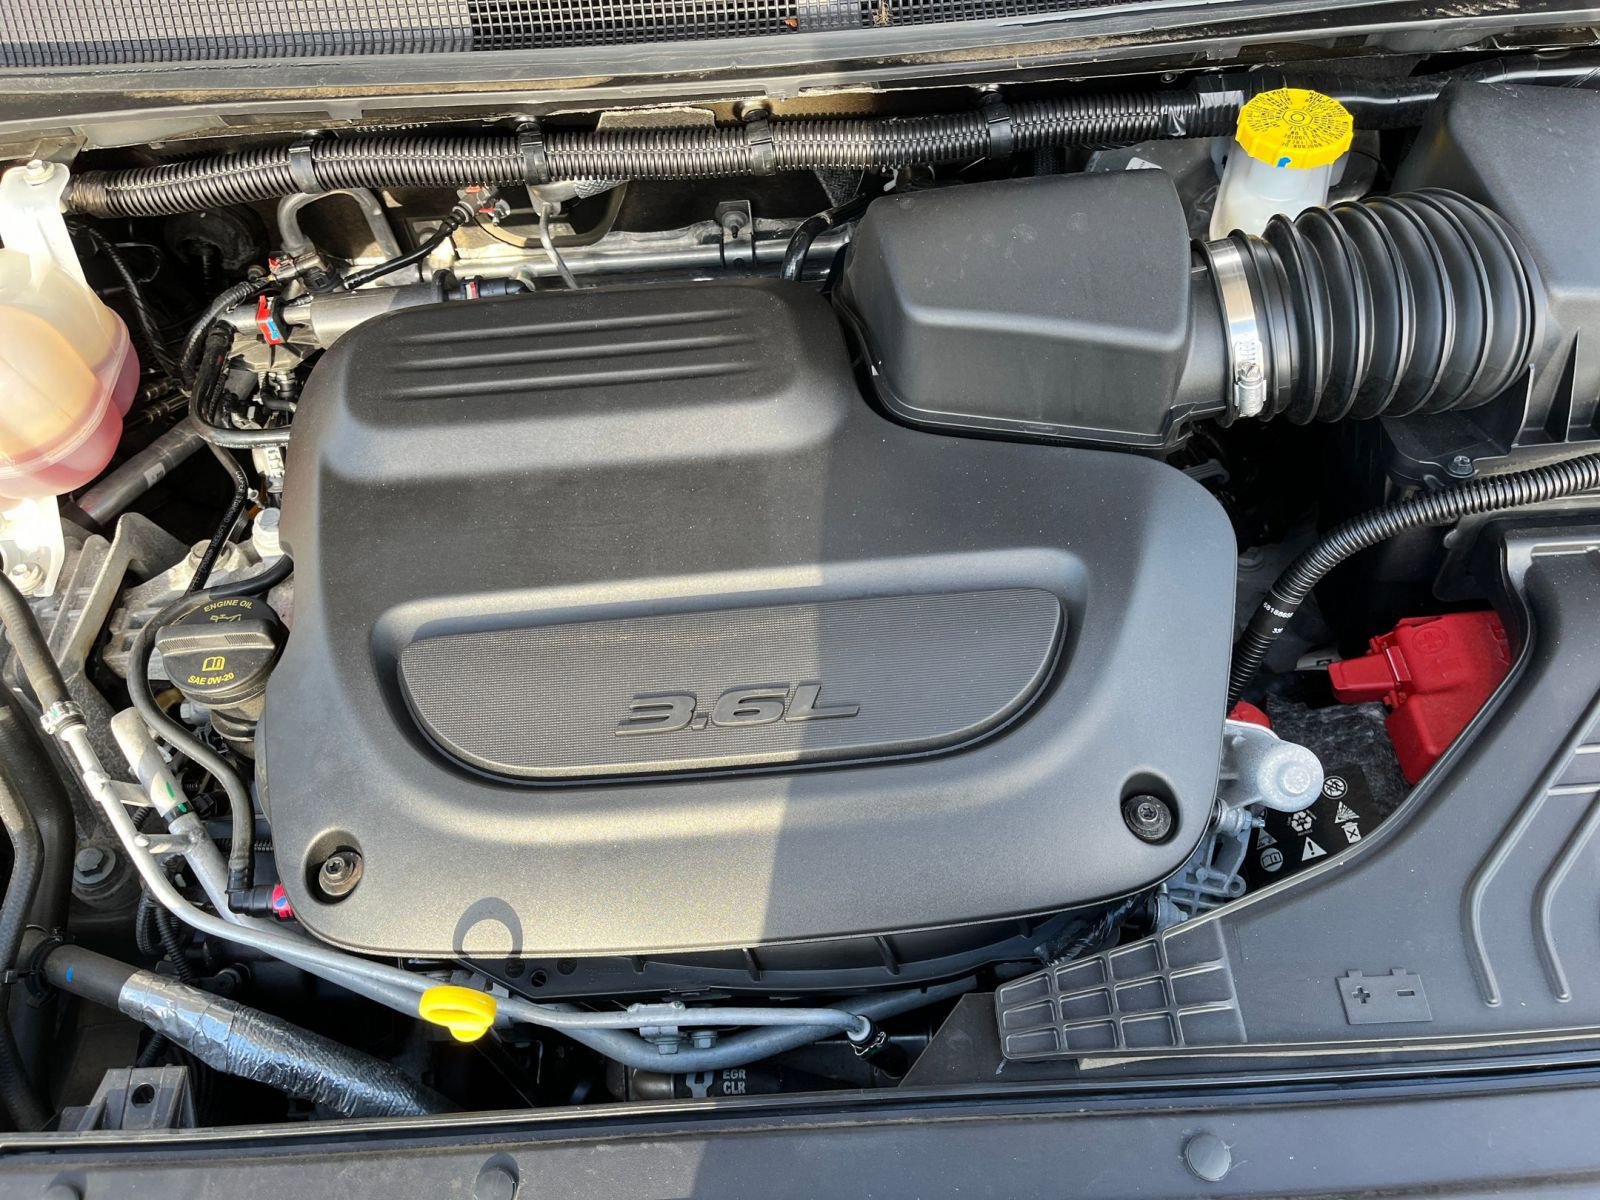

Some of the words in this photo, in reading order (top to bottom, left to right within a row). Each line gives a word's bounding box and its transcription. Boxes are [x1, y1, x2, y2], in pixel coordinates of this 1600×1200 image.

[203, 599, 239, 613] ENGINE
[239, 600, 254, 610] OIL
[188, 675, 206, 685] SAE
[207, 672, 235, 685] 0W-20
[615, 681, 861, 736] 3.6L
[722, 1069, 746, 1079] EGR
[723, 1081, 746, 1094] CLR
